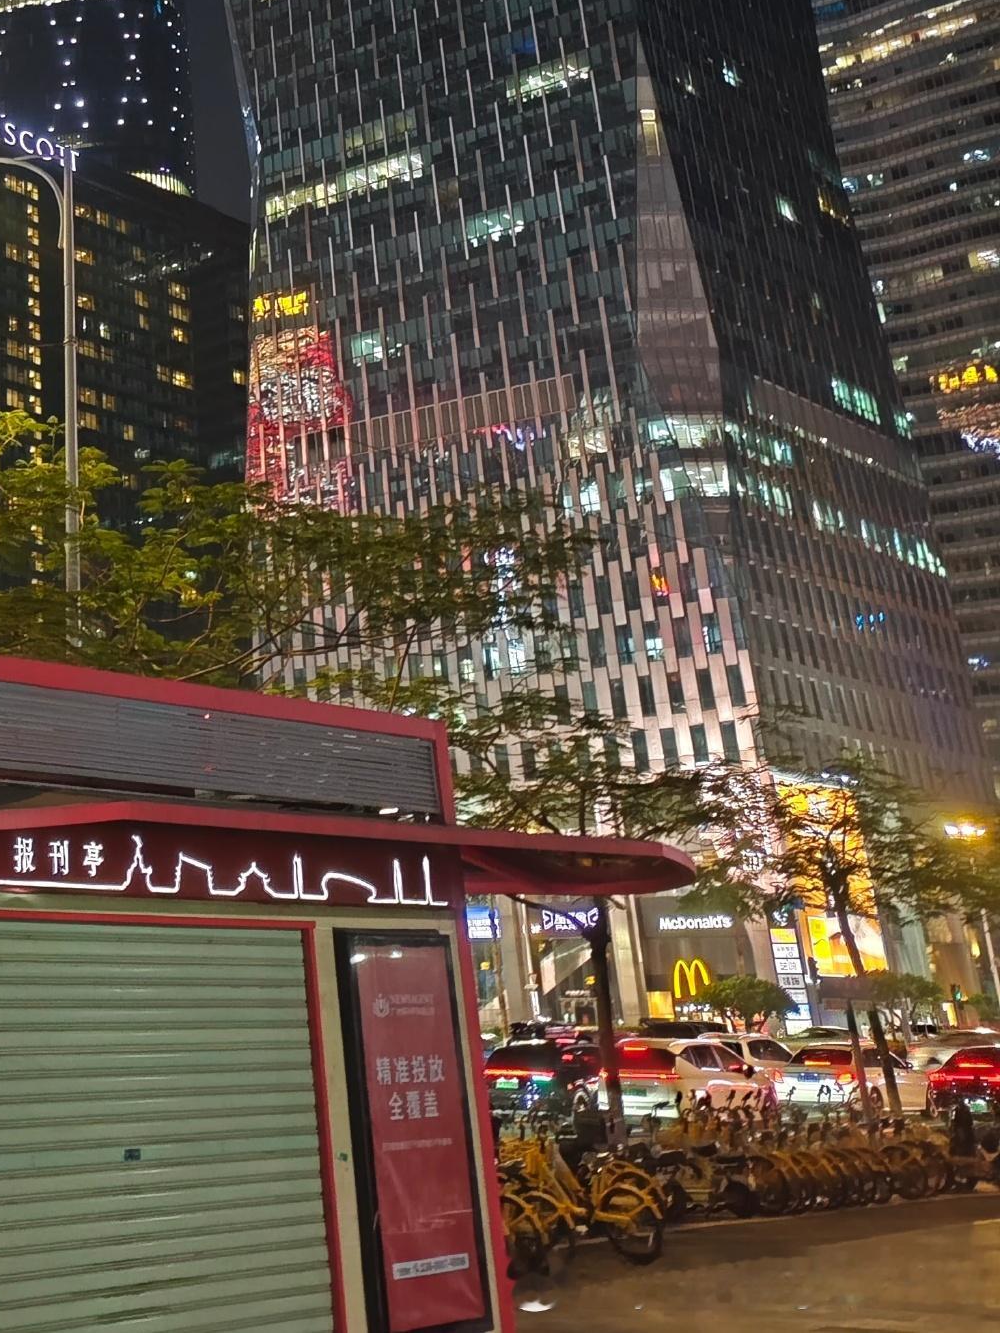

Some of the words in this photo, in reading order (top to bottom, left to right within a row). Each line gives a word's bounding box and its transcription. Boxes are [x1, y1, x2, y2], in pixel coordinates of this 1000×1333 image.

[13, 837, 104, 877] 报刊亭
[659, 914, 733, 930] McDonald's
[376, 1054, 445, 1085] 精准投放
[388, 1090, 439, 1121] 全覆盖
